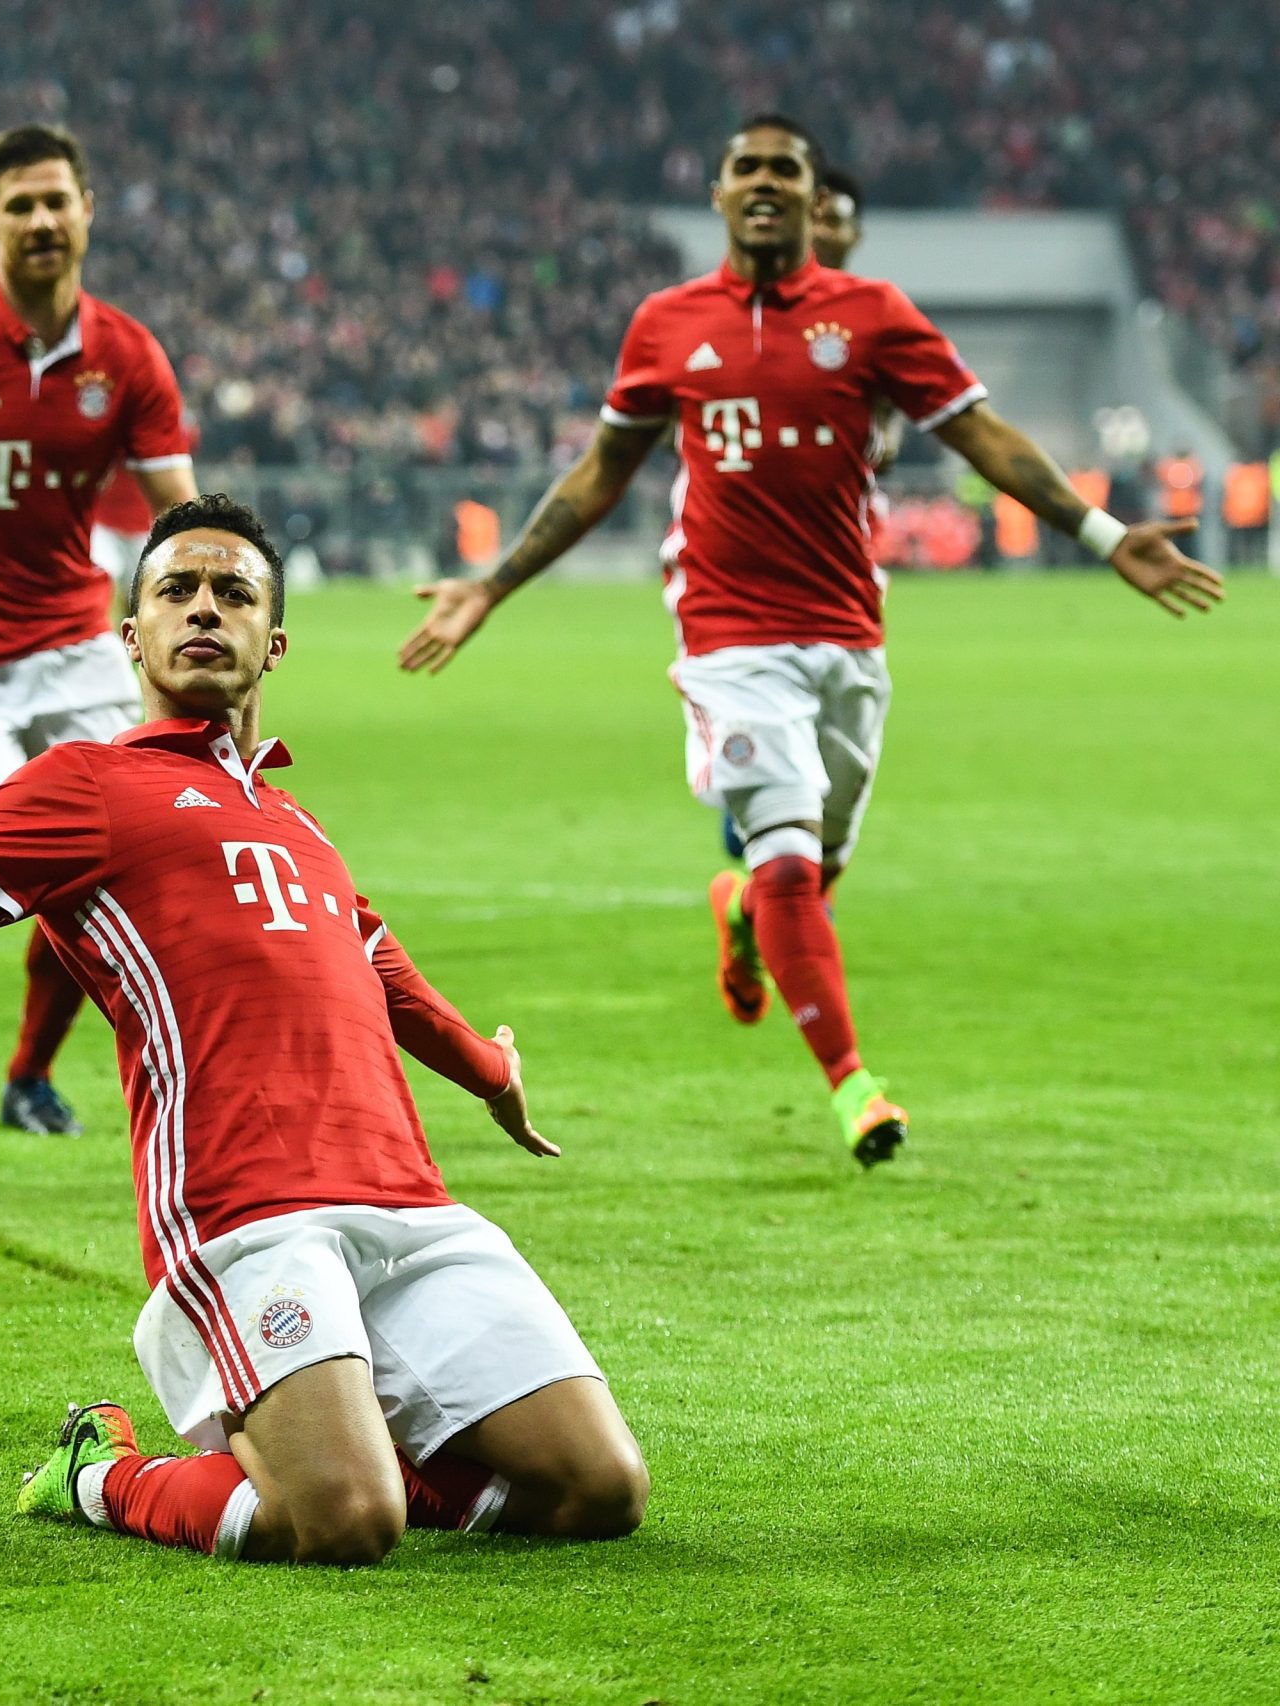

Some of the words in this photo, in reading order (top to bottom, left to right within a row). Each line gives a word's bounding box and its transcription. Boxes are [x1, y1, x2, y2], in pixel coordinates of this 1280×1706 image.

[701, 397, 762, 472] T
[173, 798, 222, 808] adidas
[221, 841, 308, 931] T
[265, 1302, 305, 1317] BAYERN
